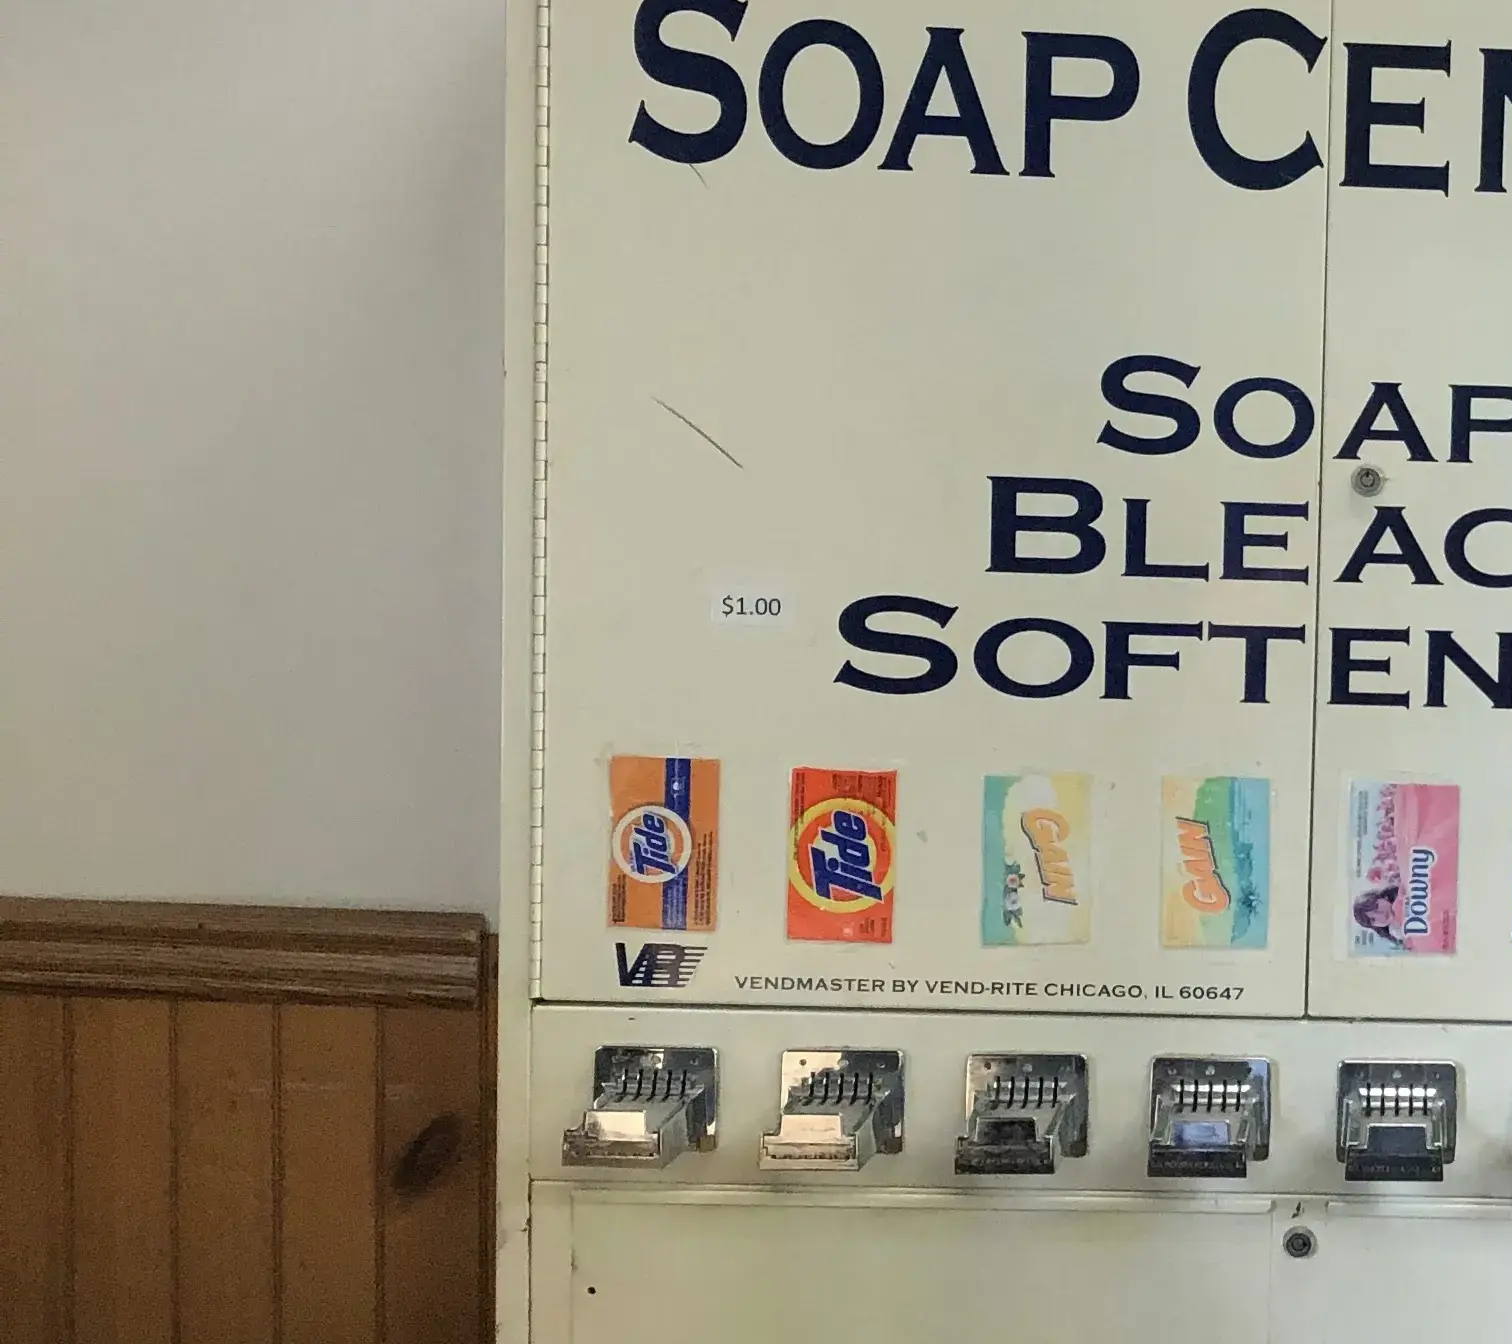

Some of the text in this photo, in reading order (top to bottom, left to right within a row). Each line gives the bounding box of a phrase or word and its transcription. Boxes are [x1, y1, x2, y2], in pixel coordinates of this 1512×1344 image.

[721, 594, 782, 618] $1.00
[633, 812, 678, 875] Tide
[810, 810, 883, 901] Tide
[1403, 848, 1435, 935] Downy
[735, 976, 1244, 1001] VENDMASTER BY VEND-RITE CHICAGO, IL 60647
